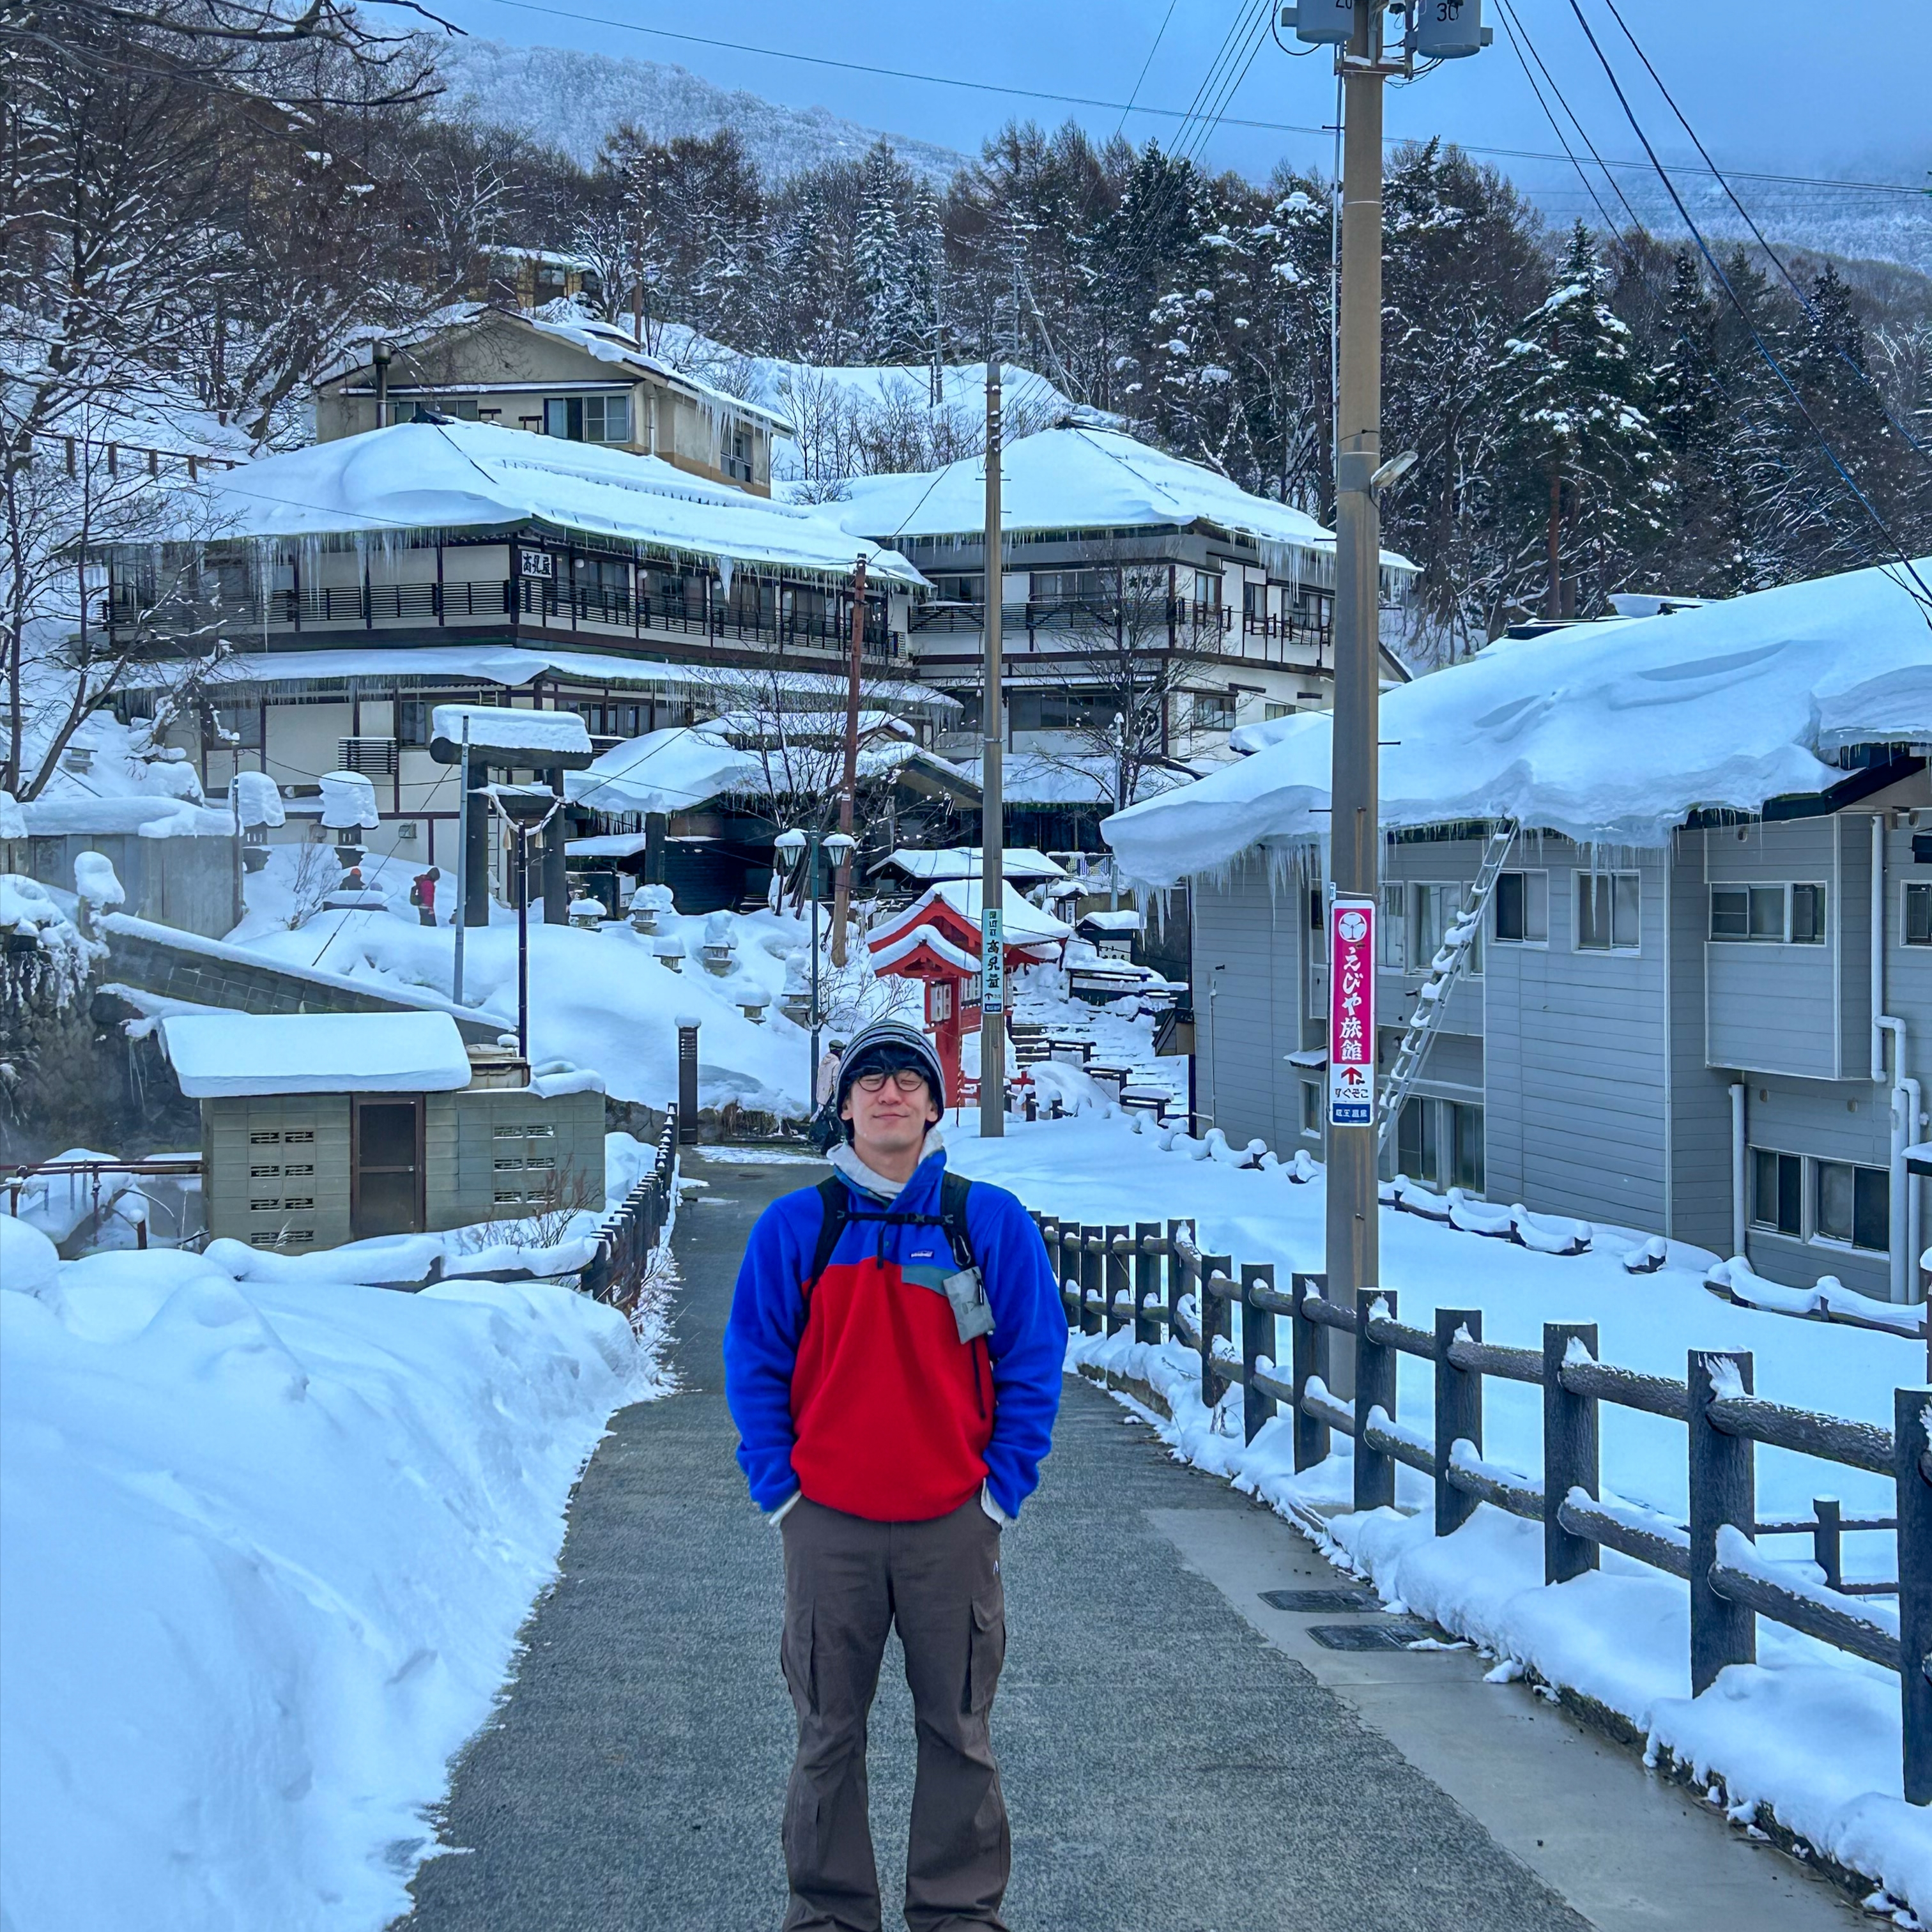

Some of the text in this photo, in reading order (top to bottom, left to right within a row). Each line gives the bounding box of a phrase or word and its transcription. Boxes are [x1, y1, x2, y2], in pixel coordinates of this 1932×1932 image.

[1437, 2, 1459, 22] 30
[1339, 946, 1363, 1061] えびや旅館
